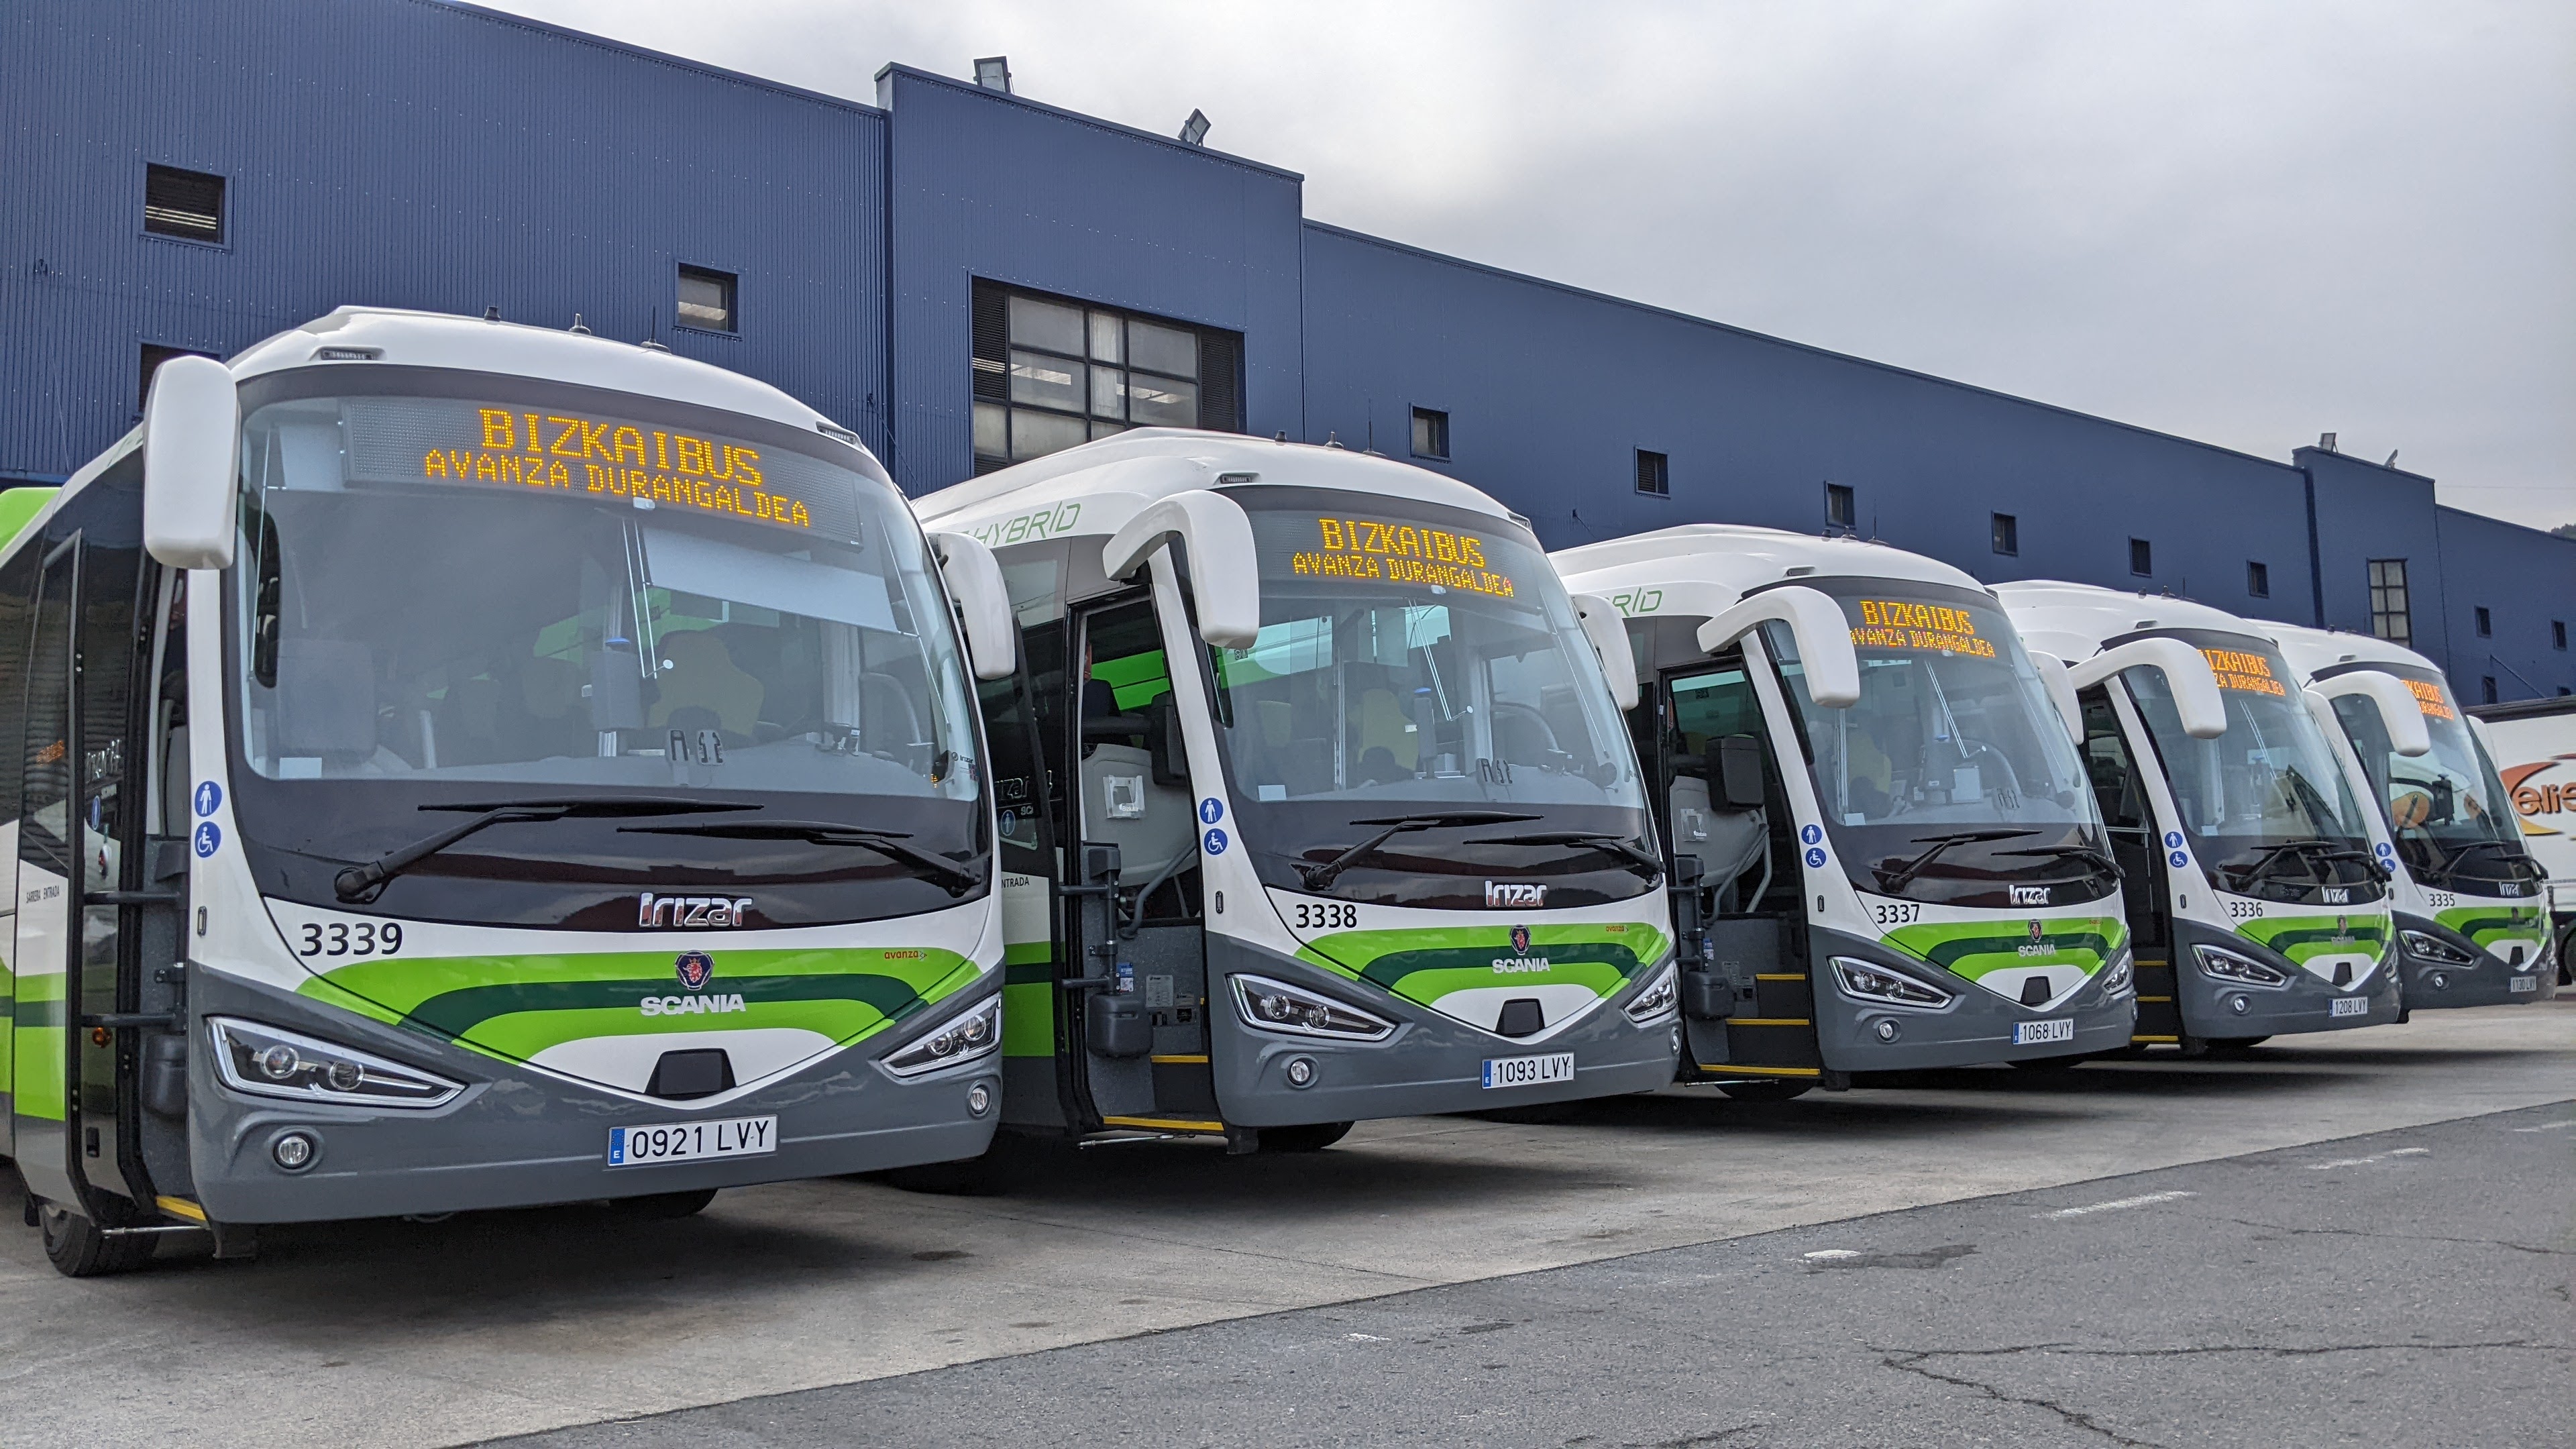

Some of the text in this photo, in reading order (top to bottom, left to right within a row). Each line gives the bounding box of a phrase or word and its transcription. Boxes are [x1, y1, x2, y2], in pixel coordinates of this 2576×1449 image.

[479, 409, 762, 486] BIZKAIBUS
[425, 449, 810, 527] AVANZA DURANGALDEA
[1319, 518, 1485, 568] BIZKAIBUS
[1293, 552, 1514, 597] AVANZA DURANGALDEA
[1606, 586, 1662, 616] RID
[1860, 601, 1974, 635] BIZKAIBUS
[1909, 631, 1995, 658] DURANGALDEA
[2198, 649, 2271, 677] IZKAIBUS
[1002, 876, 1030, 889] NTRADA
[1485, 880, 1548, 906] Irizar
[2008, 884, 2051, 905] Irizar
[2321, 885, 2349, 904] Iriza
[639, 892, 753, 927] Irizar
[2230, 902, 2263, 917] 3336
[2428, 893, 2455, 907] 3335
[1295, 904, 1357, 928] 3338
[1876, 904, 1920, 924] 3337
[300, 922, 403, 957] 3339
[2018, 944, 2056, 957] SCANIA
[884, 950, 919, 959] avanza
[1492, 957, 1551, 973] SCANIA
[640, 994, 747, 1016] SCANIA
[2335, 998, 2366, 1014] 1208 LVY
[2023, 1023, 2049, 1041] 1068
[2052, 1021, 2071, 1038] LVY
[1497, 1059, 1536, 1083] 1093
[1542, 1056, 1570, 1079] LVY
[632, 1126, 702, 1159] 0921
[717, 1120, 769, 1151] LVY
